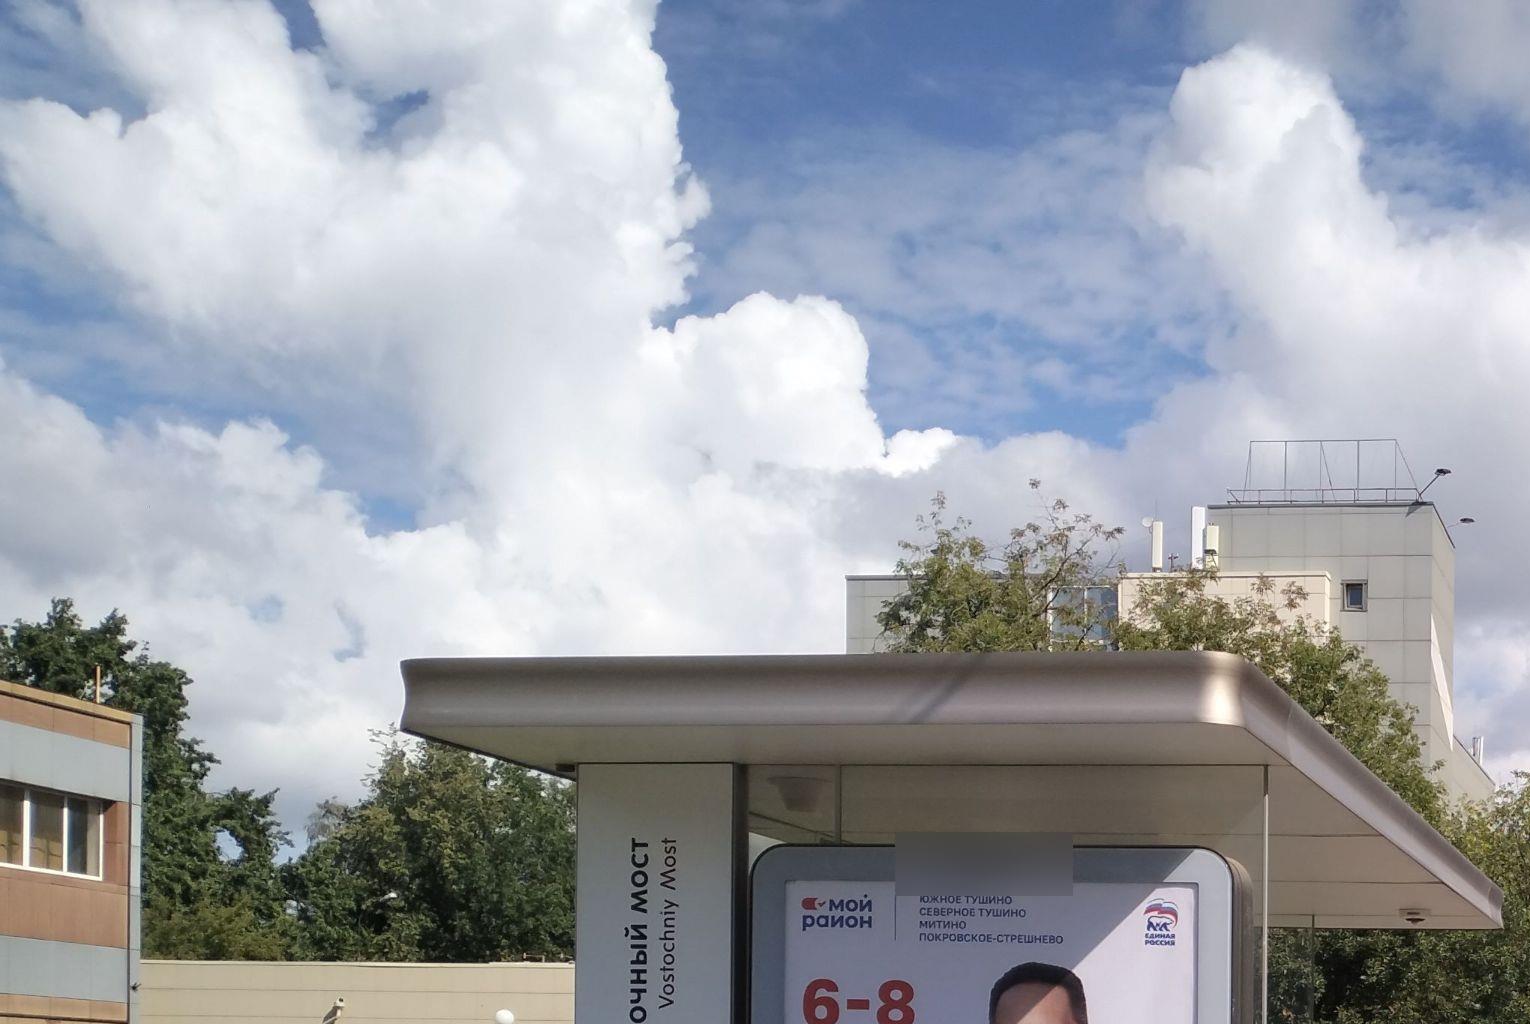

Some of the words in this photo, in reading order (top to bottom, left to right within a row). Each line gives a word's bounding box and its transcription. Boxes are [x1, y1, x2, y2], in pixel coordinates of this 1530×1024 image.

[660, 837, 677, 891] Most
[919, 895, 962, 904] ЮЖНОЕ
[965, 895, 1013, 905] ТУШИНО
[919, 907, 975, 917] СЕВЕРНОЕ
[978, 908, 1026, 918] ТУШИНО
[919, 920, 967, 930] МИТИНО
[919, 932, 1064, 944] ПОКРОВСКОЕ-СТРЕШНЕВО
[658, 899, 680, 1010] Vostochniy
